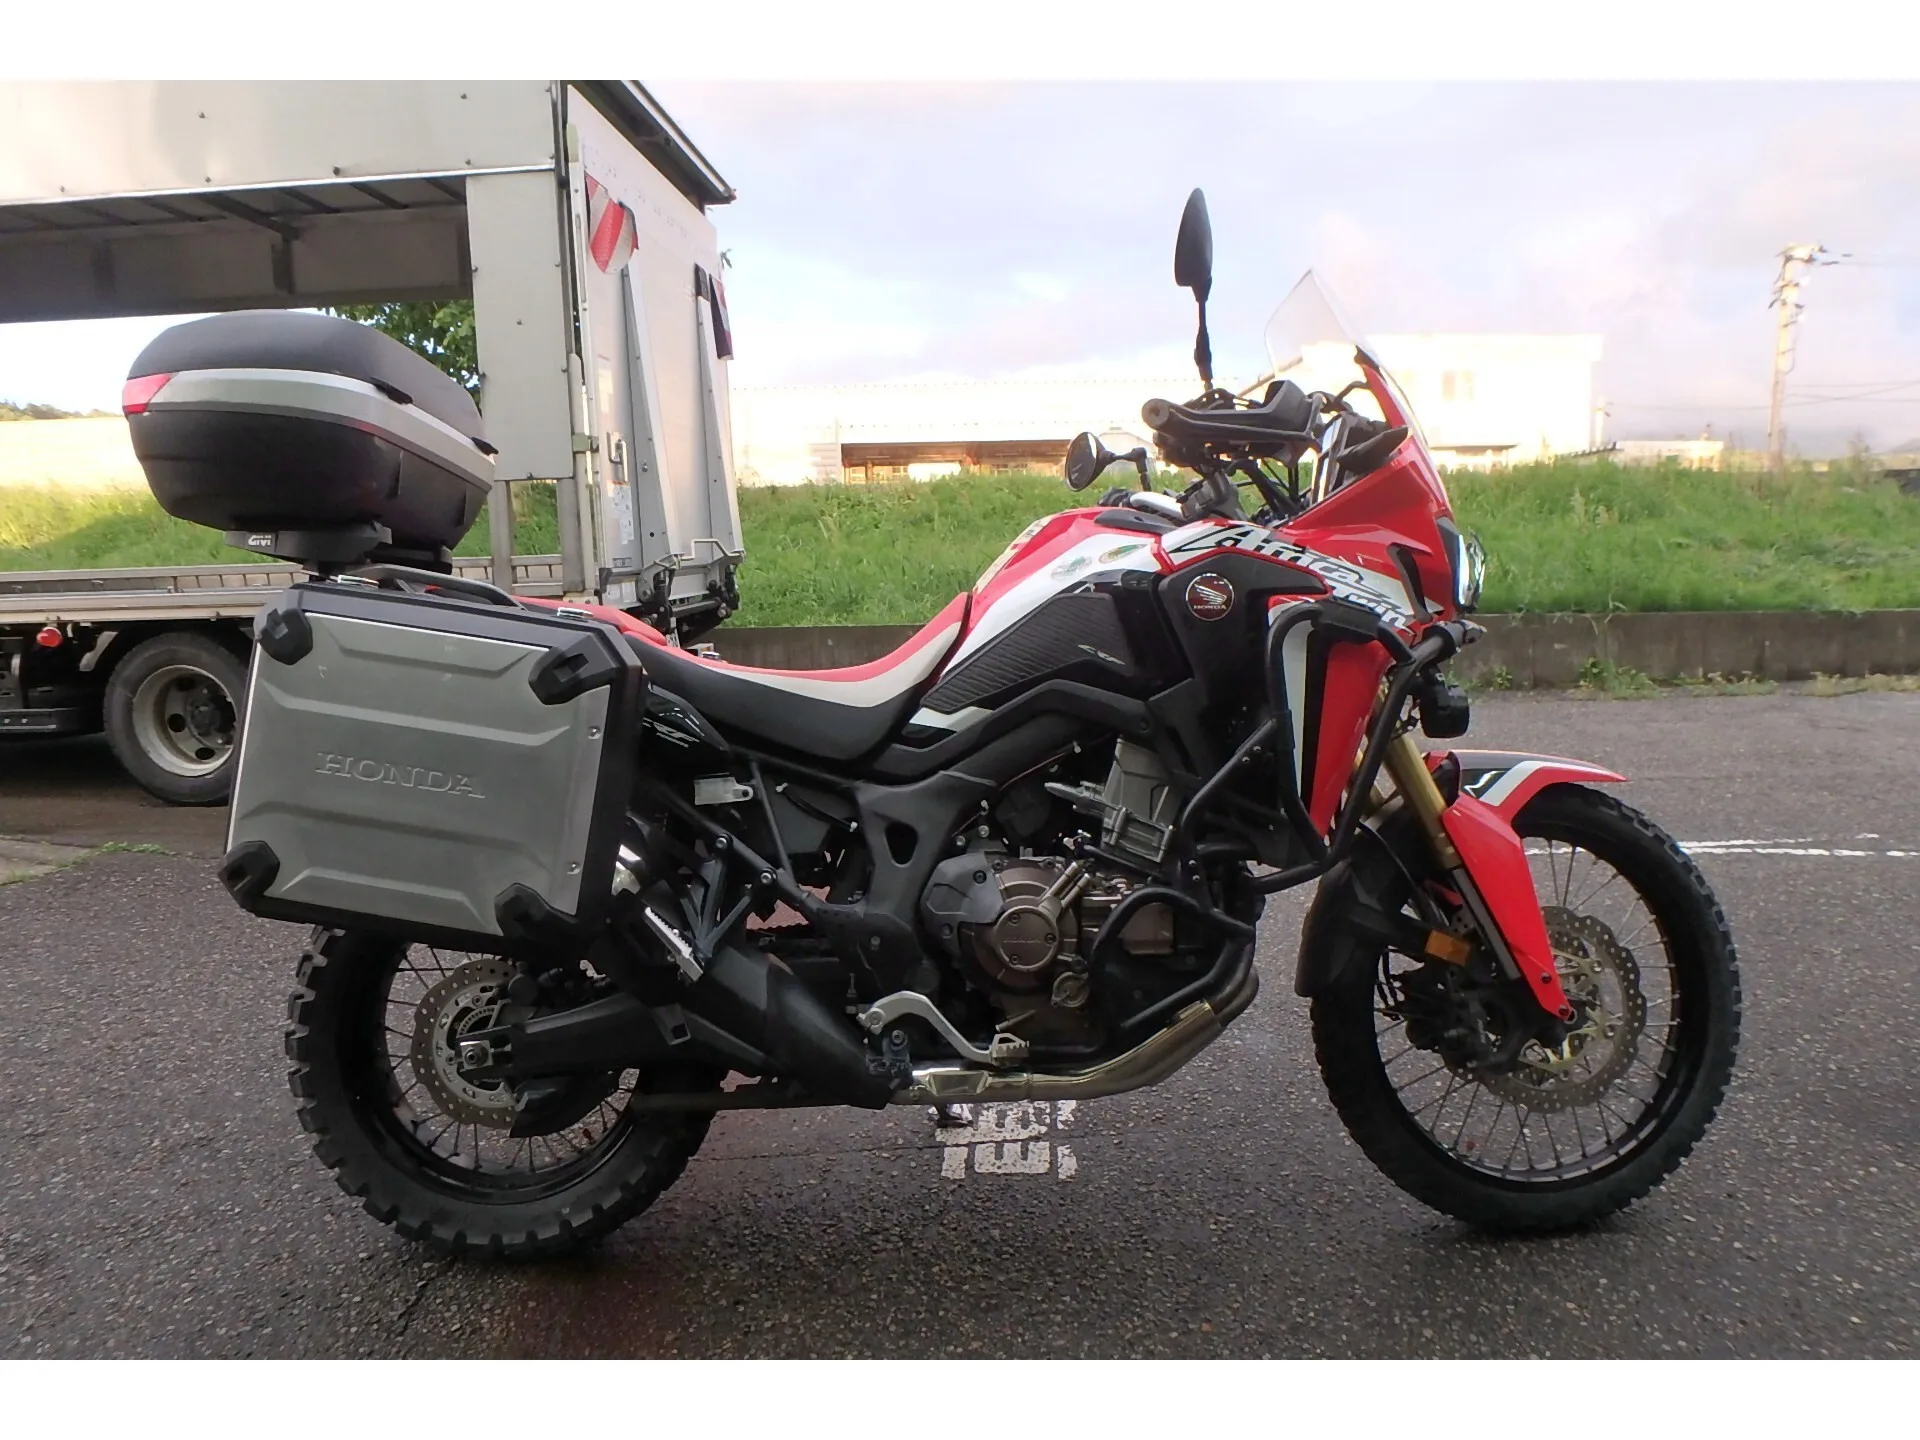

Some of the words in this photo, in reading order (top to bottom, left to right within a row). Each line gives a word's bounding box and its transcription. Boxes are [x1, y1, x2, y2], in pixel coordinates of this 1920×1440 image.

[1172, 525, 1359, 584] Africa
[1325, 577, 1416, 636] Twin
[314, 752, 486, 799] HONDA
